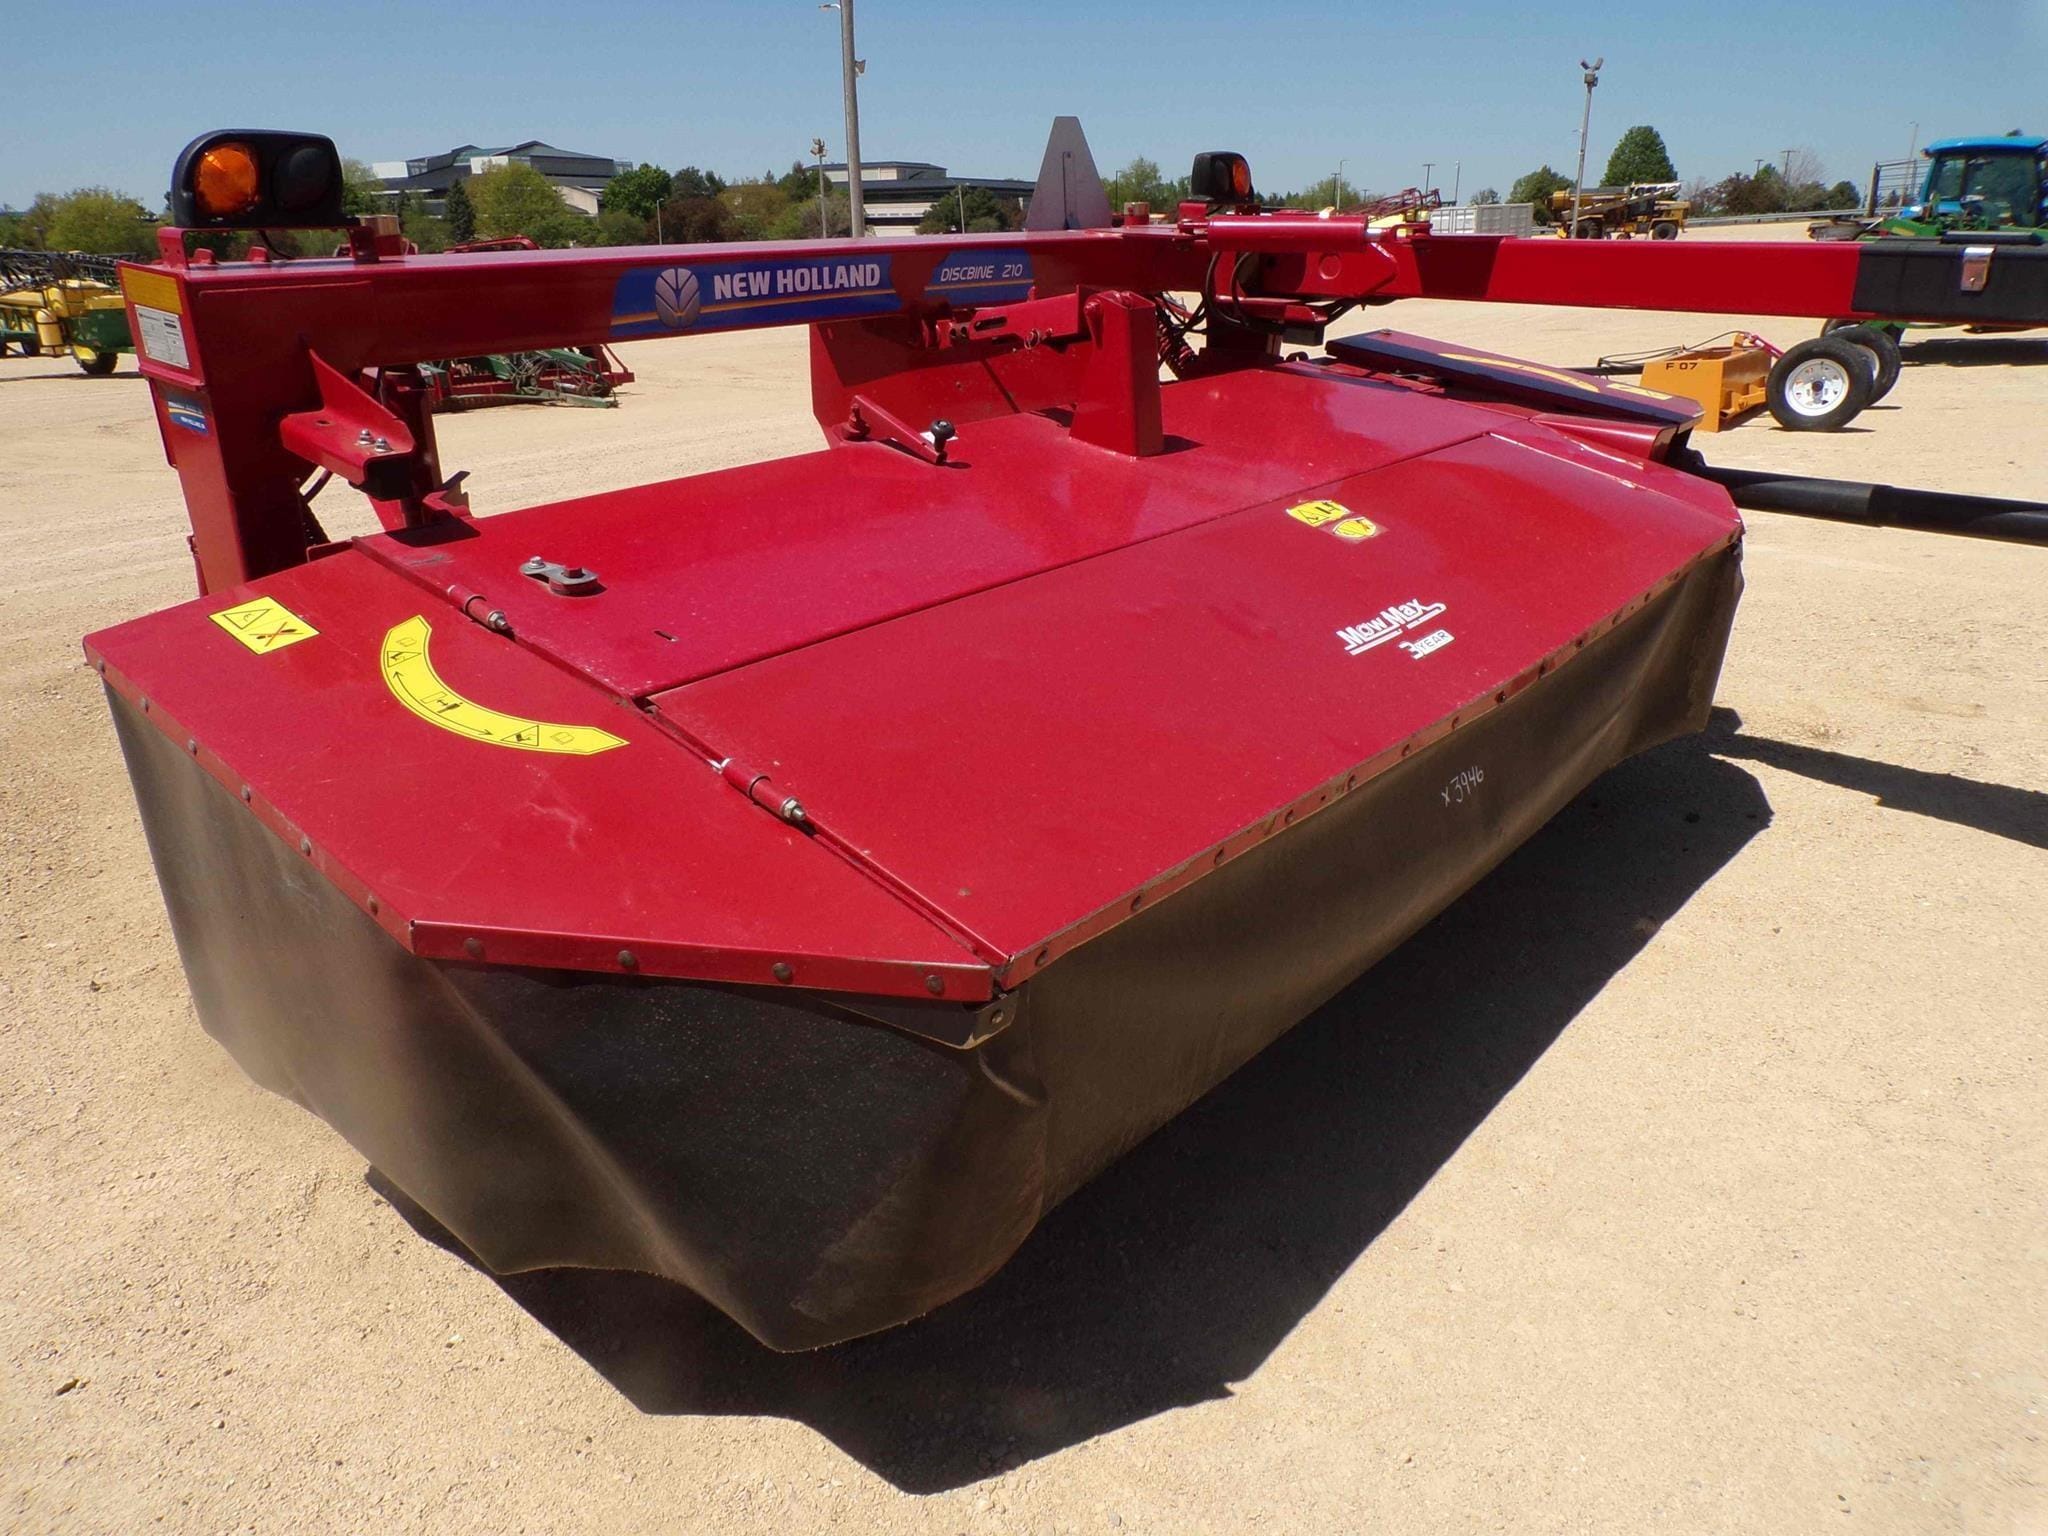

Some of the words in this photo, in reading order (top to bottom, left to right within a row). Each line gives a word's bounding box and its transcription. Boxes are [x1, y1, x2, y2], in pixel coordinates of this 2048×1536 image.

[713, 270, 771, 300] NEW
[777, 263, 881, 294] HOLLAND
[940, 264, 995, 282] DISCBINE
[1002, 263, 1024, 278] 210
[1665, 362, 1675, 370] F
[1679, 362, 1698, 370] 07
